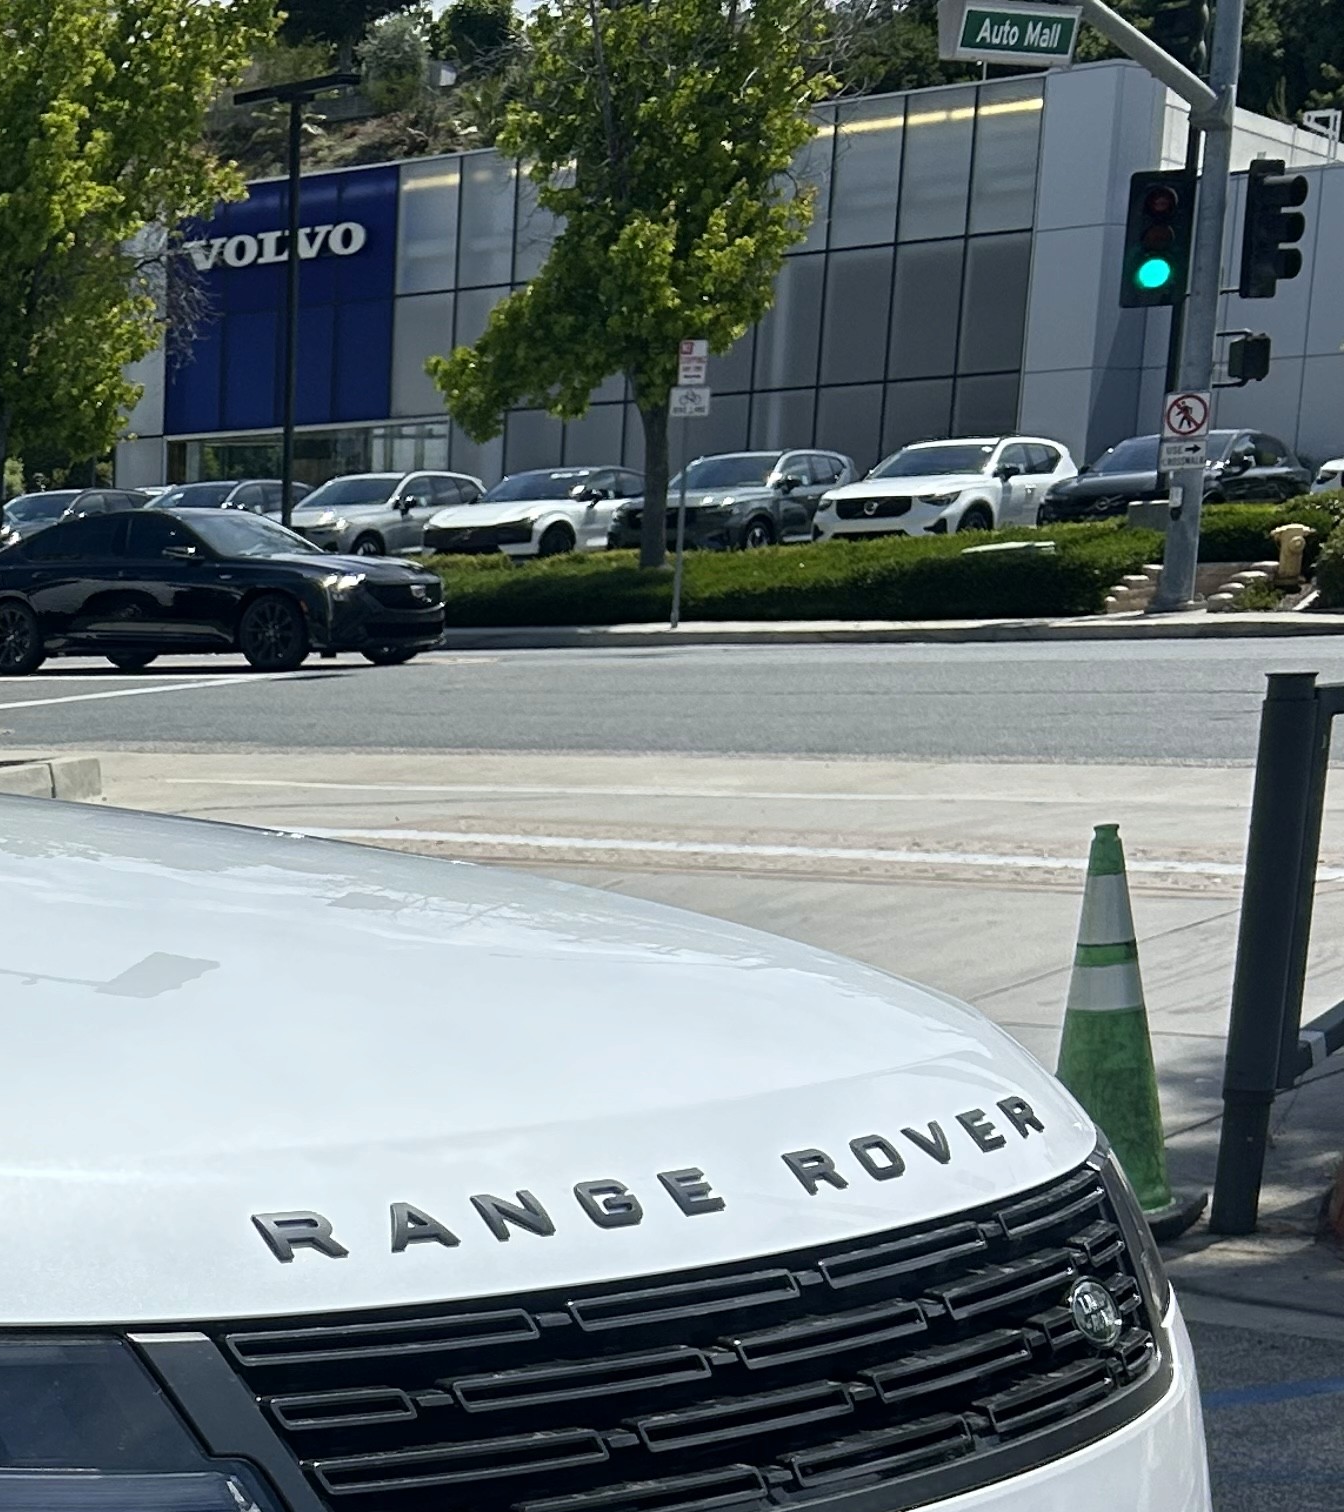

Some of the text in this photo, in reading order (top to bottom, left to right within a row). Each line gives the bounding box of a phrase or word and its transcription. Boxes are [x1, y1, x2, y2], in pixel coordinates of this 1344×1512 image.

[976, 18, 1061, 48] Auto Mall
[182, 221, 366, 271] VOLVO
[251, 1095, 1045, 1263] RANGE ROVER
